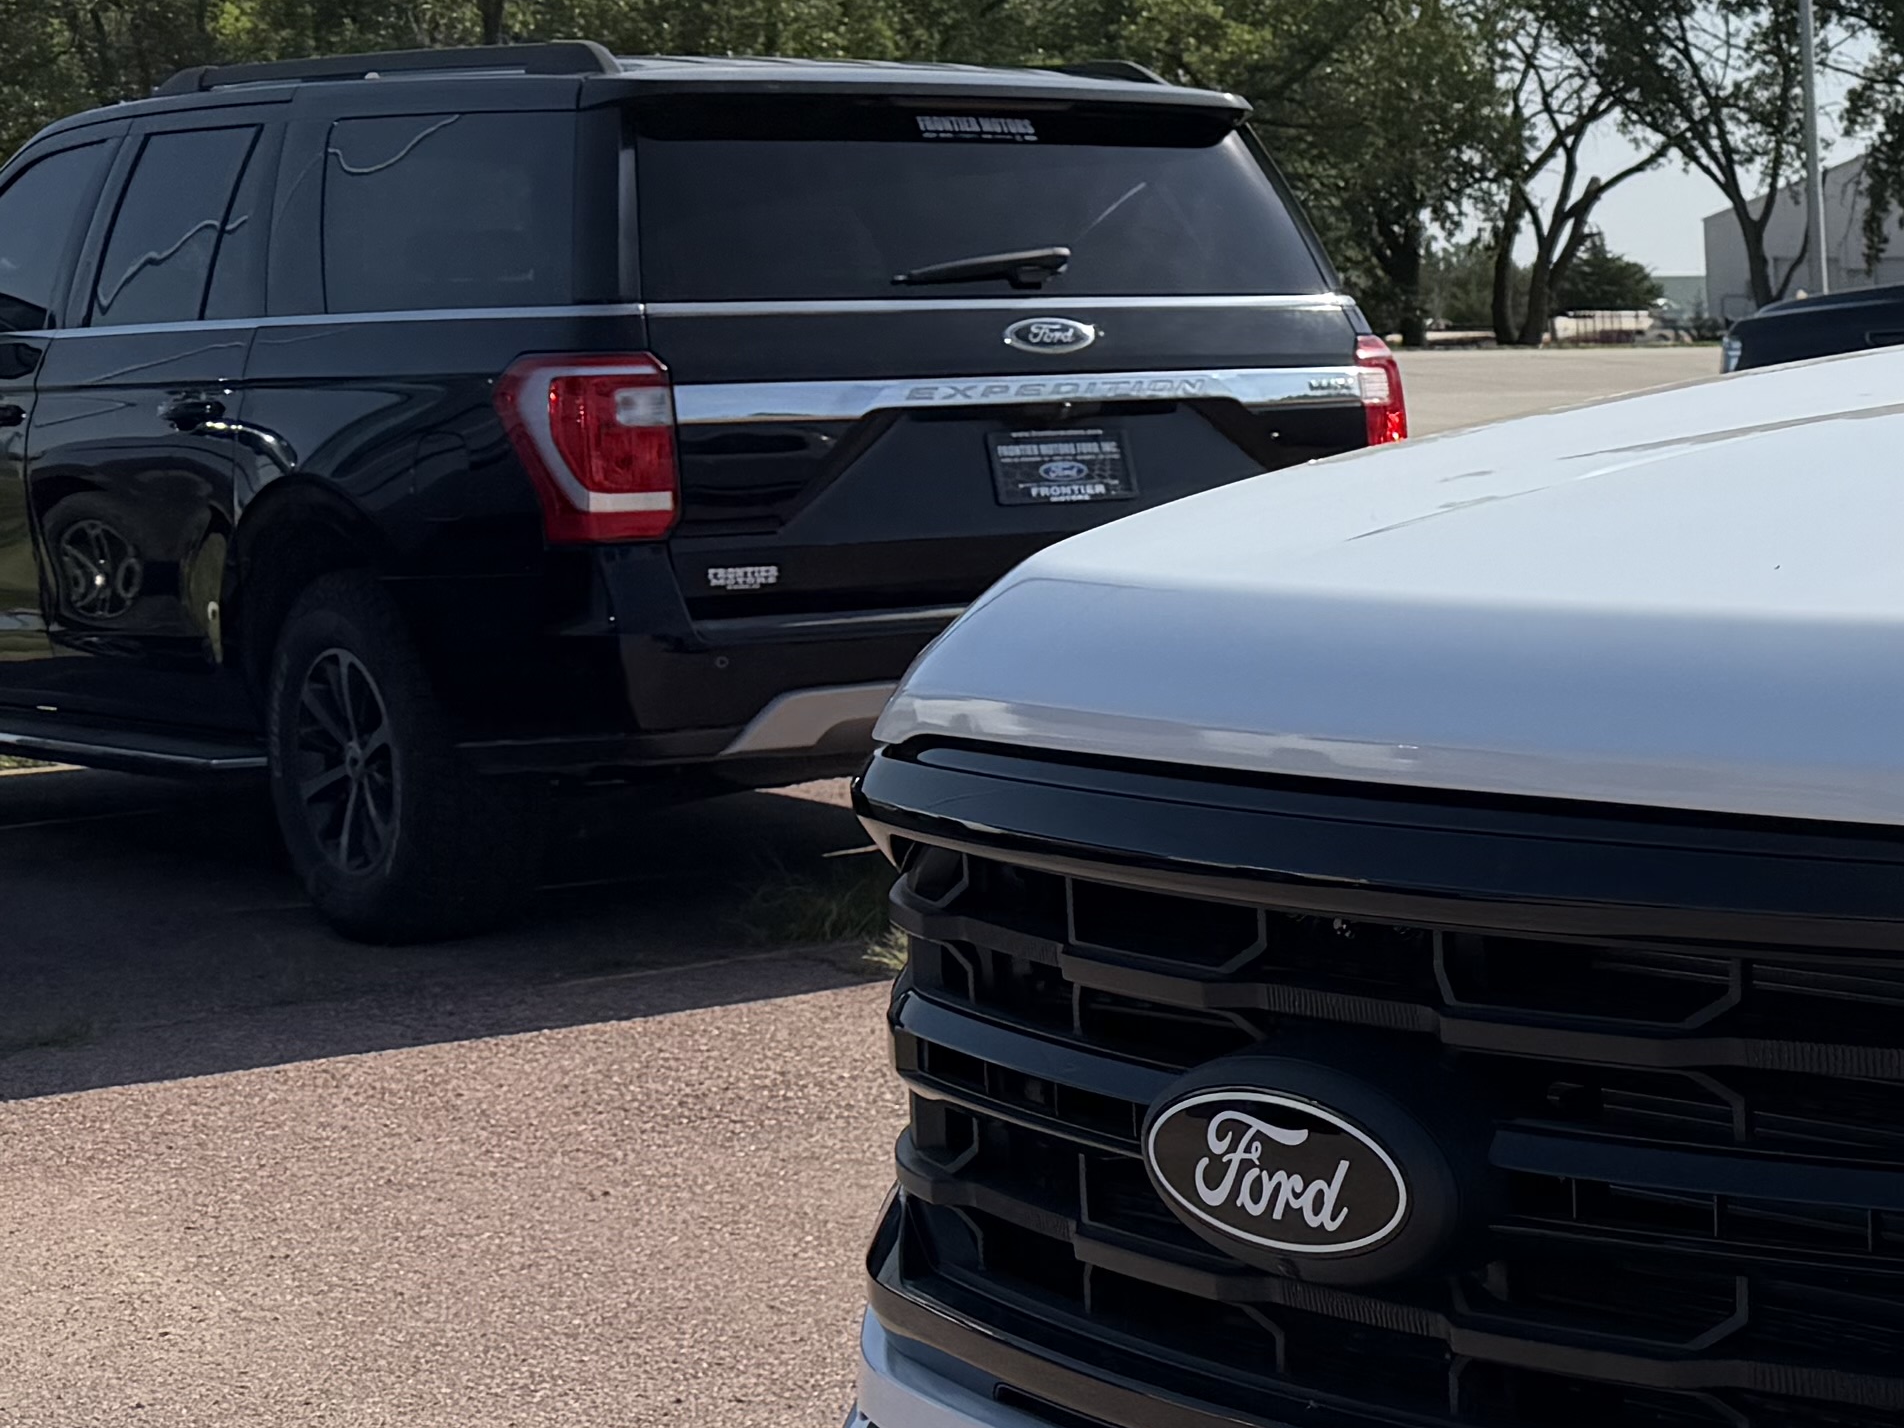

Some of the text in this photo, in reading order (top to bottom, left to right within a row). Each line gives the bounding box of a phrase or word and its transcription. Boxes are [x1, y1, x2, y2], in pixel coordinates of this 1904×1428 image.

[1028, 323, 1074, 343] Ford
[905, 377, 1205, 401] EXPEDITION
[1195, 1110, 1350, 1232] Ford
